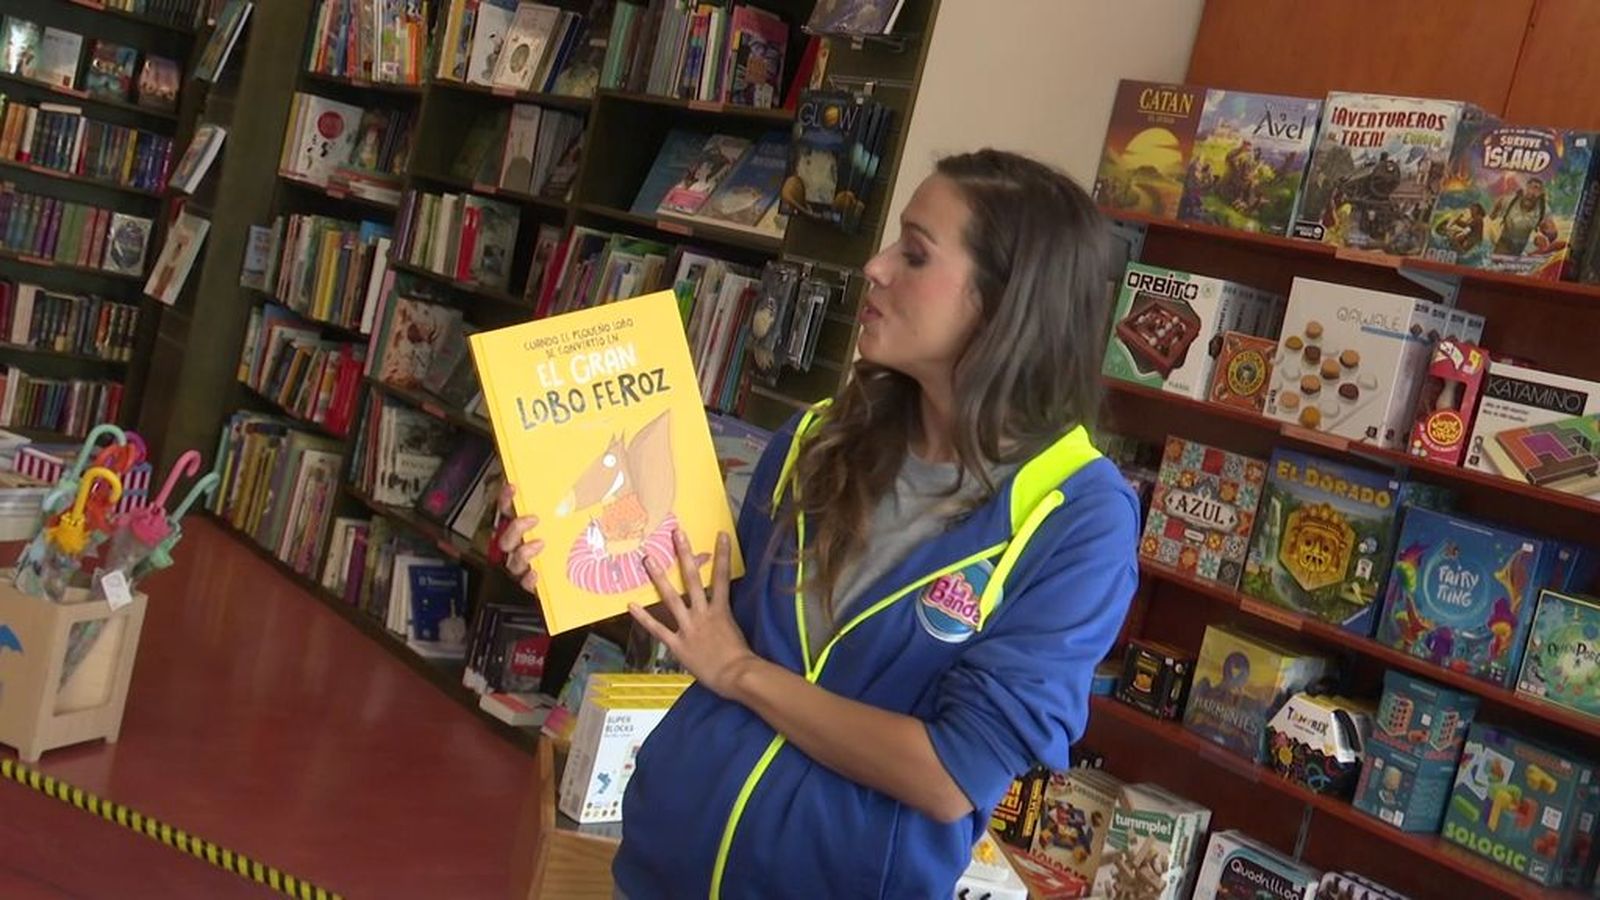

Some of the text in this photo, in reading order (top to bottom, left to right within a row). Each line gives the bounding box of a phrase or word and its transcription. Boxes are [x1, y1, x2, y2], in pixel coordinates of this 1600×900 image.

[1140, 88, 1193, 114] CATAN
[1253, 110, 1306, 140] Avel
[1341, 130, 1385, 148] TREN!
[536, 341, 639, 389] EL GRAN
[516, 367, 672, 430] LOBO FEROZ
[1487, 379, 1581, 412] KATAMINO
[1276, 460, 1392, 508] EL DORADO
[1175, 495, 1224, 524] AZUL
[1115, 813, 1172, 836] tummple!
